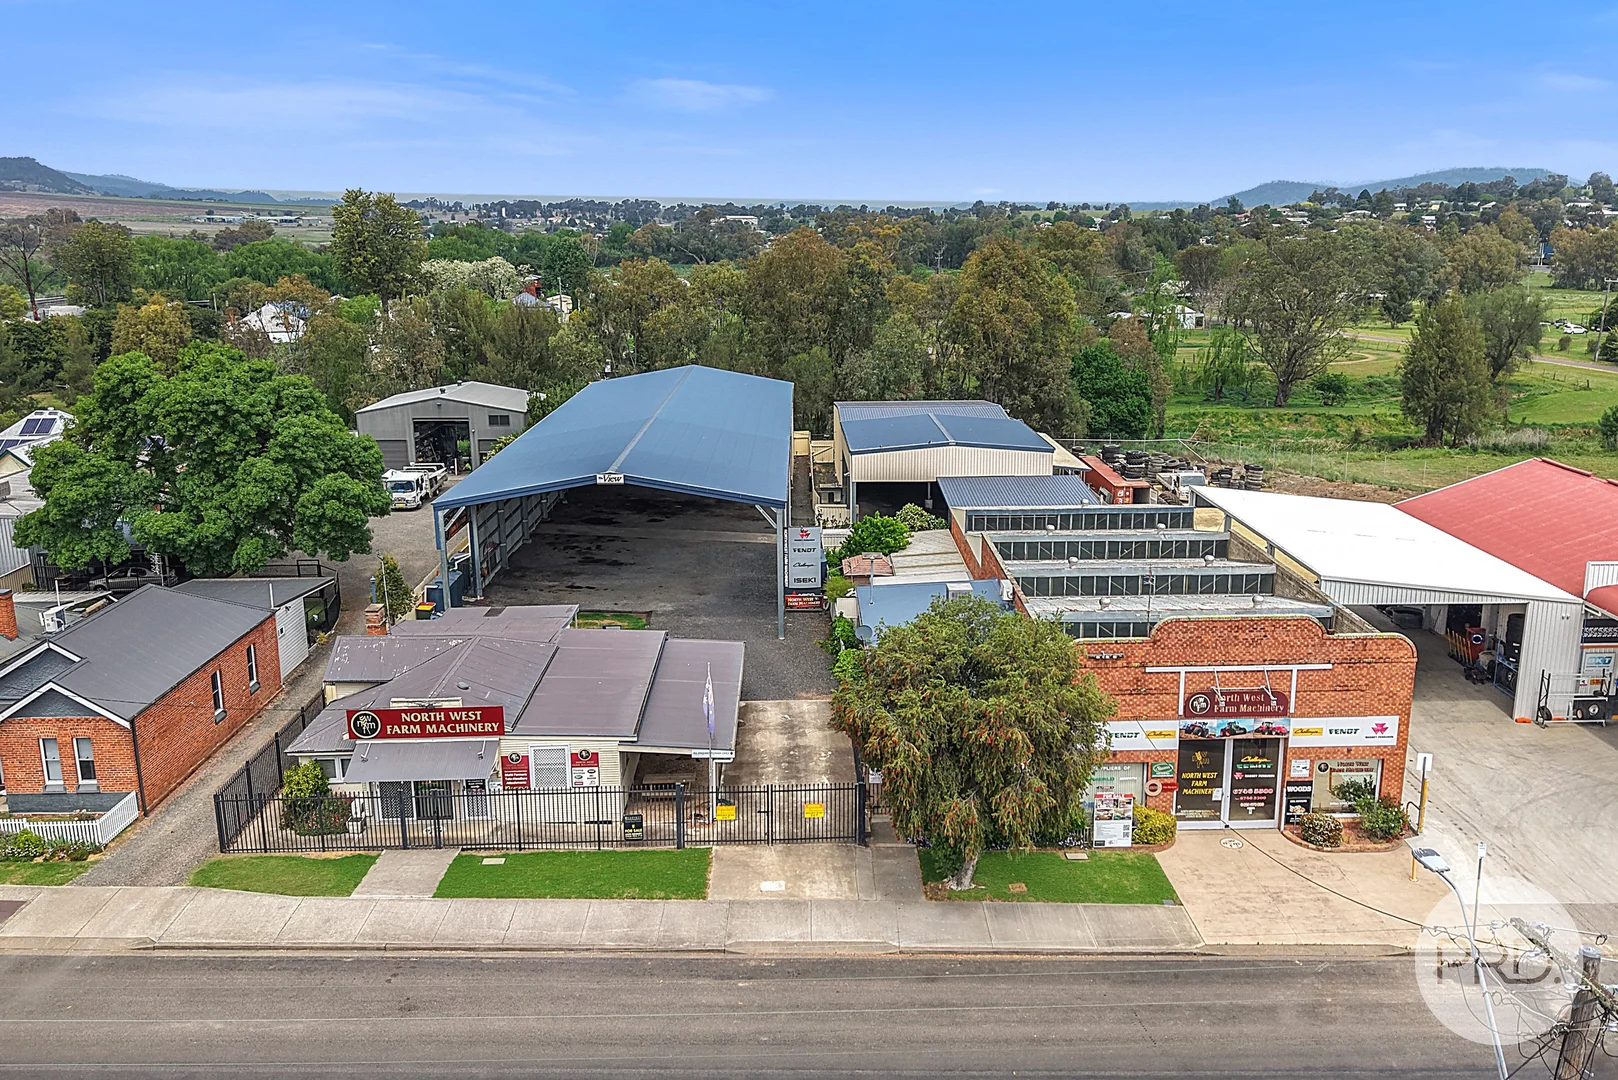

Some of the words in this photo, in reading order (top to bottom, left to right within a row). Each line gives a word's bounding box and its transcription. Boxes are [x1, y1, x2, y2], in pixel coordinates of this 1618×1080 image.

[603, 474, 623, 483] View
[1242, 693, 1264, 702] West
[1214, 704, 1237, 713] Farm
[1239, 702, 1284, 713] Machinery
[401, 713, 445, 722] NORTH
[449, 711, 482, 721] WEST
[387, 724, 421, 735] FARM
[426, 722, 499, 734] MACHINERY
